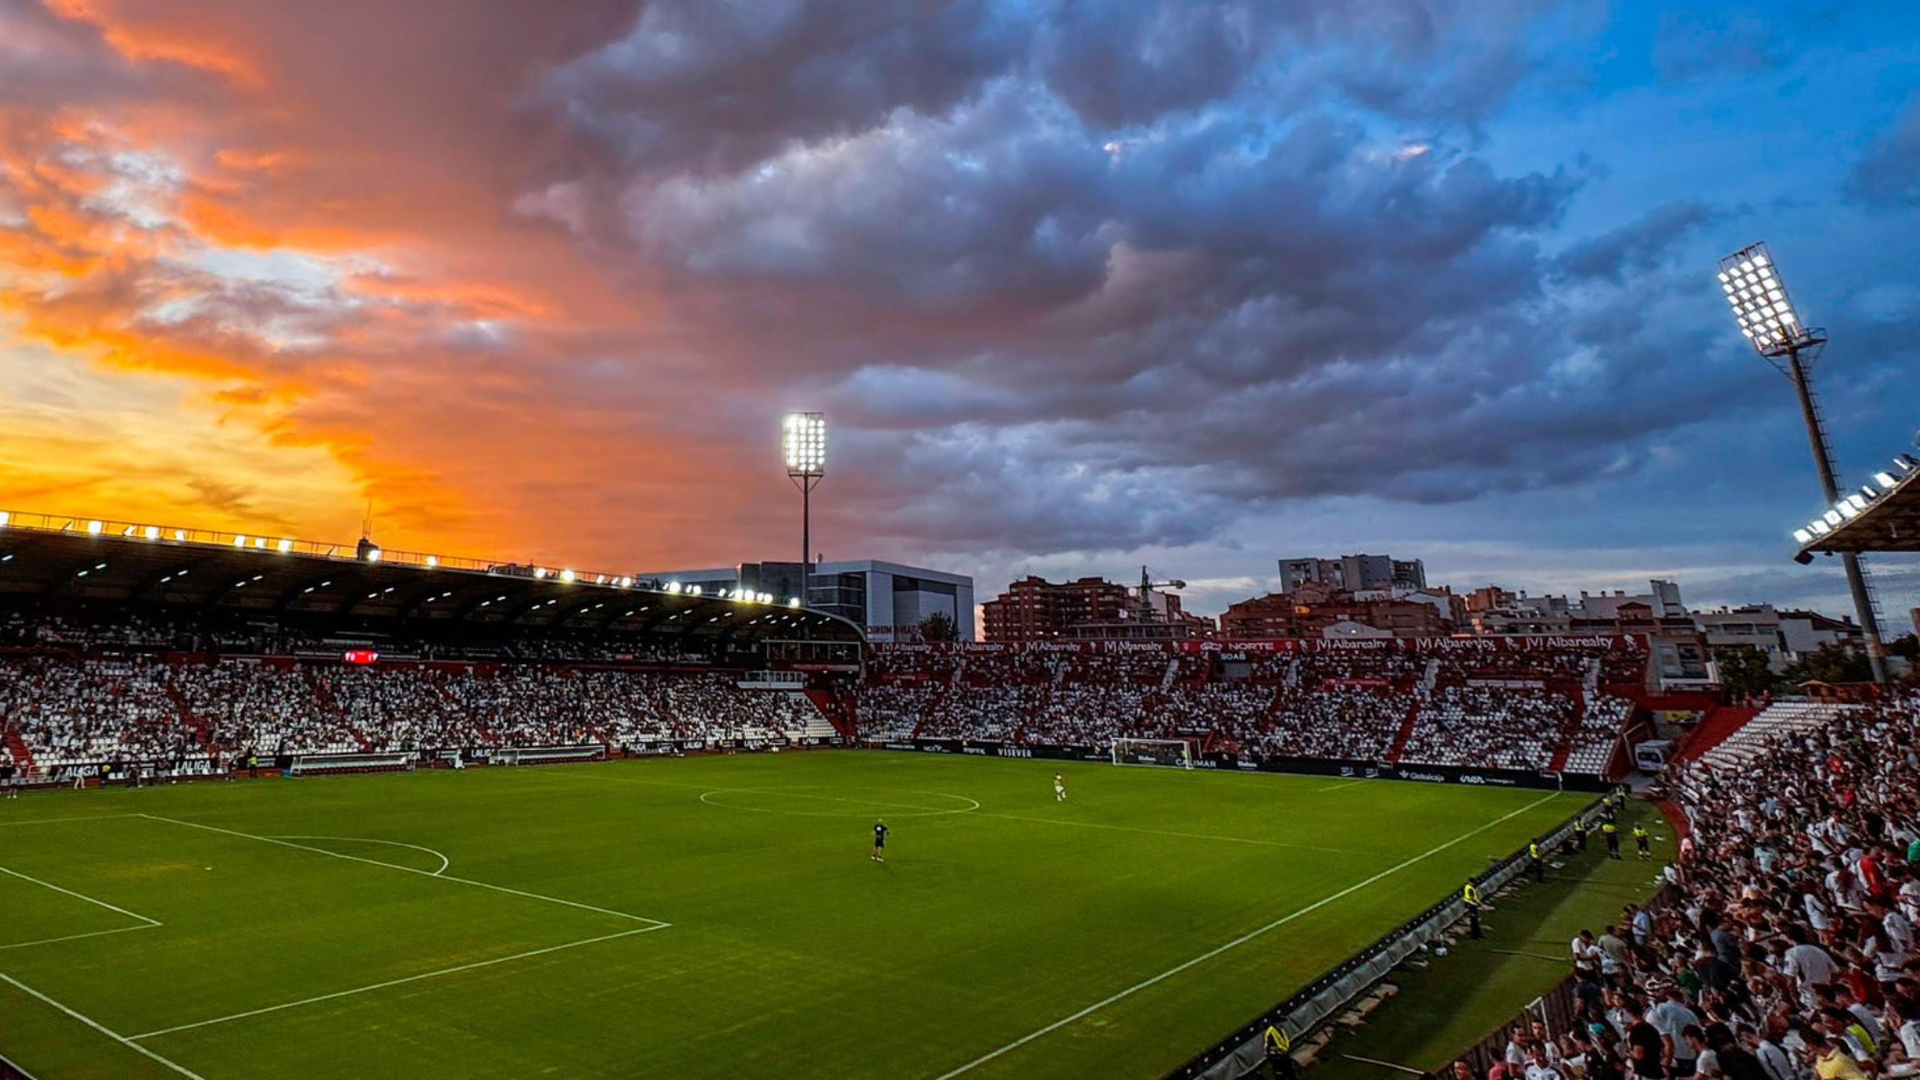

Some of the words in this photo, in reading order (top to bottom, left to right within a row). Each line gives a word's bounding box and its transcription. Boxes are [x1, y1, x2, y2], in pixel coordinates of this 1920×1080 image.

[1228, 641, 1275, 651] NORTE
[1333, 638, 1388, 650] Albarealty
[1546, 635, 1613, 648] Albarealty
[683, 741, 703, 750] LALIGA
[997, 747, 1033, 758] VISEVER
[174, 760, 211, 773] LALIGA
